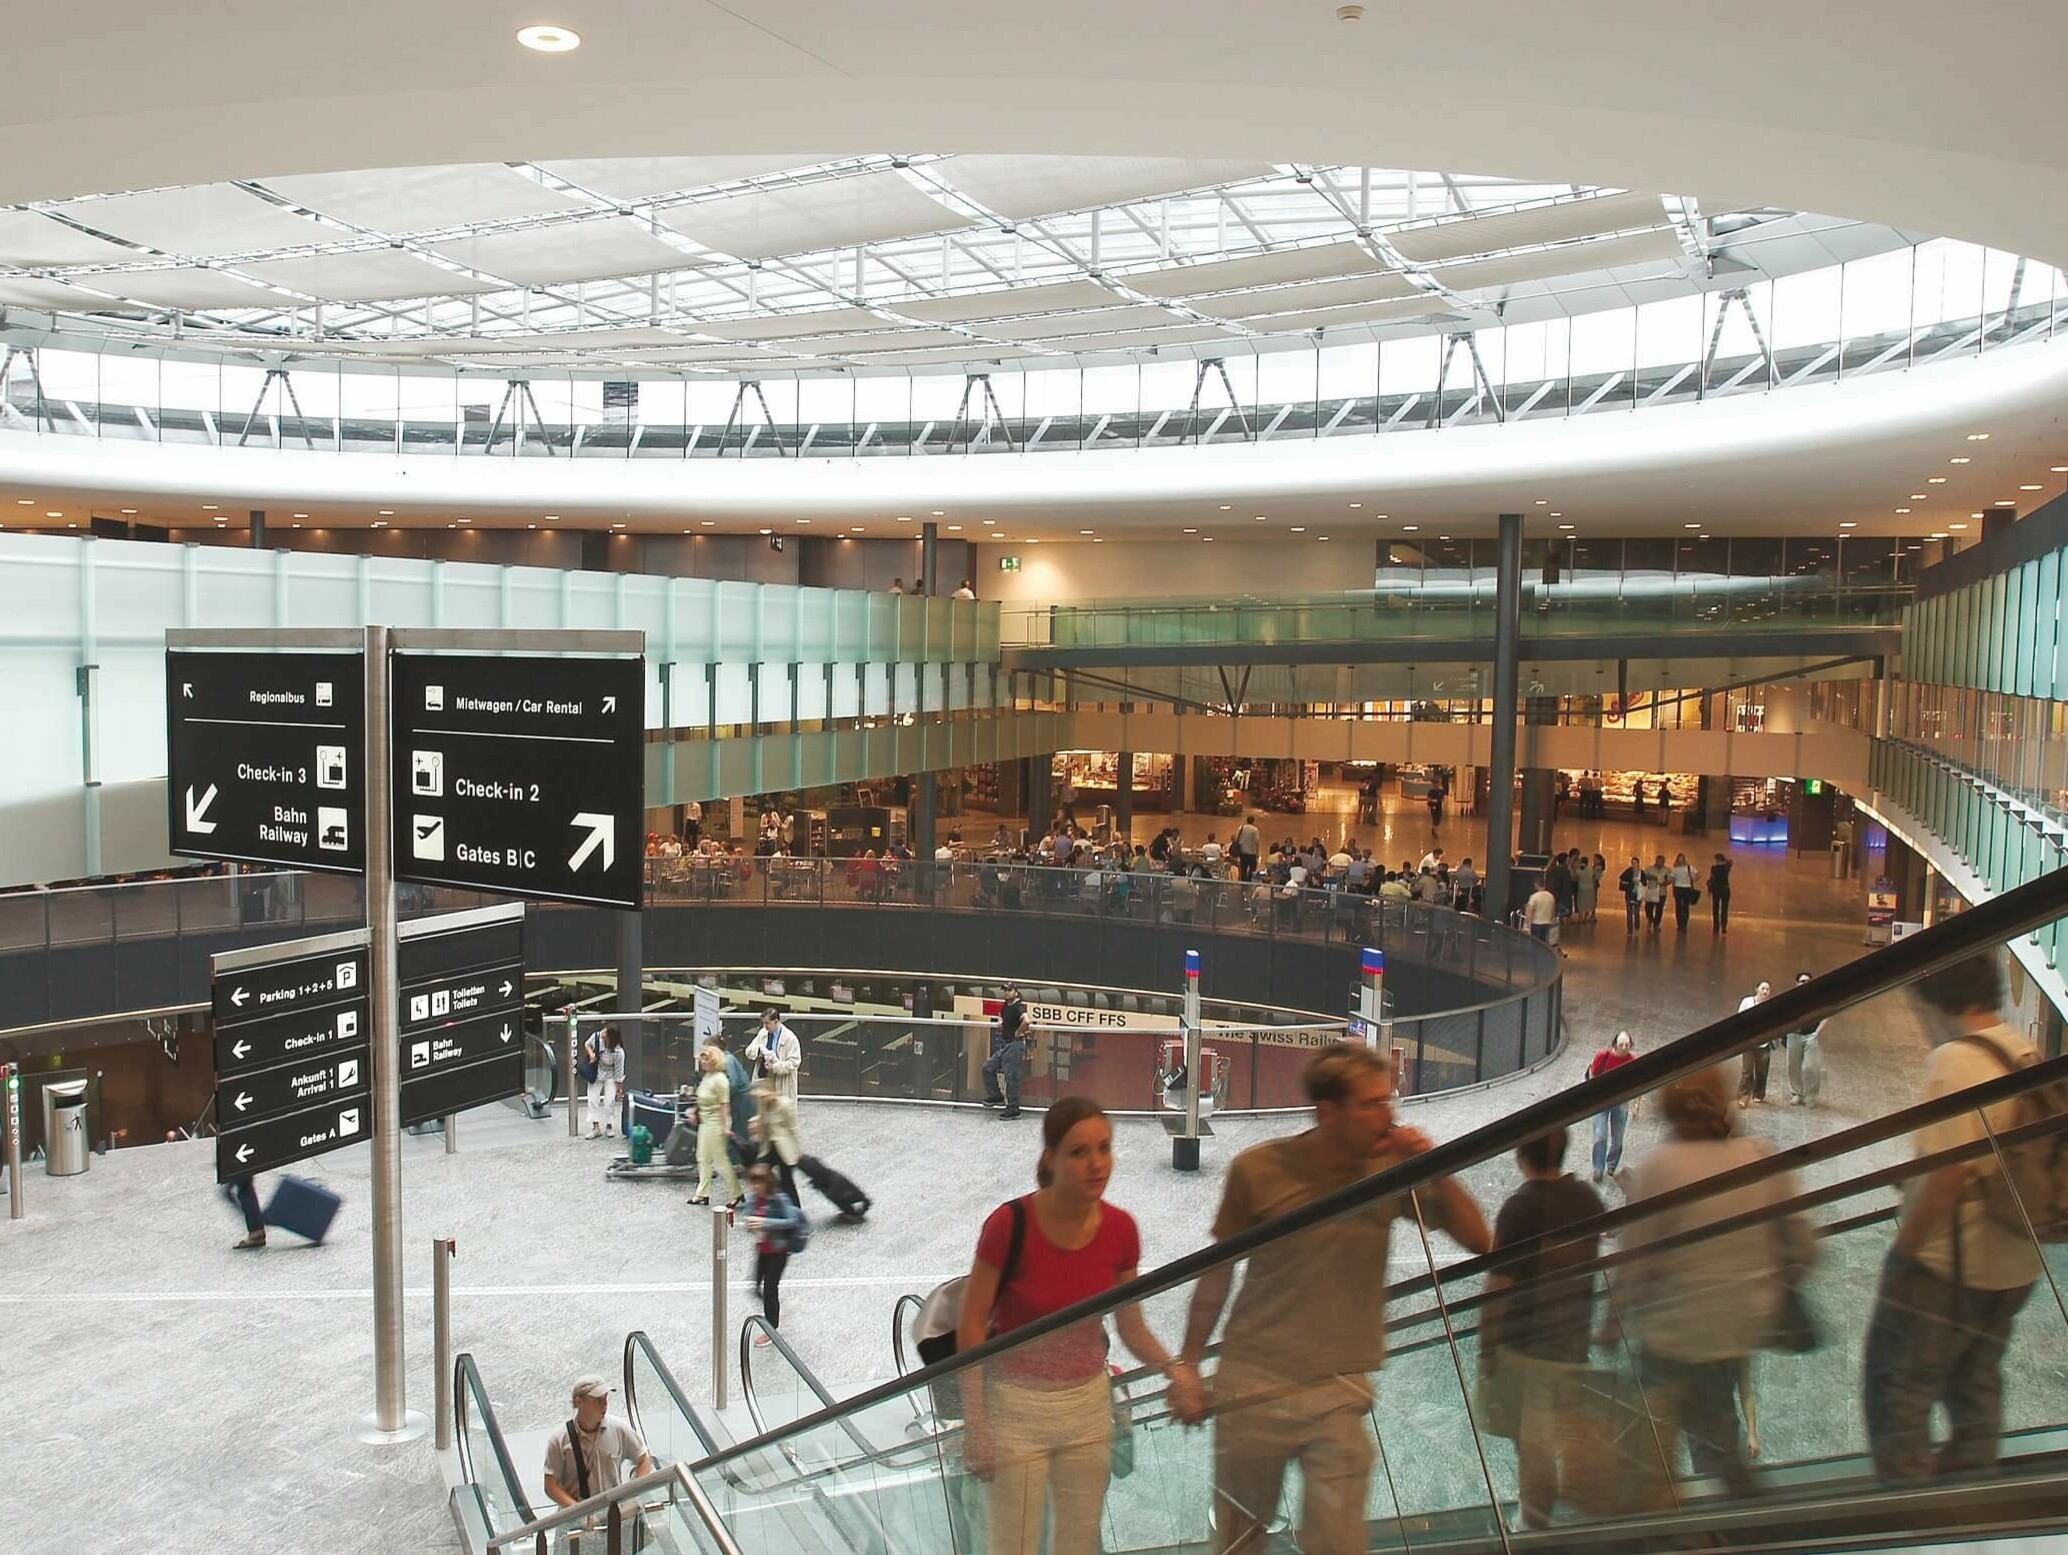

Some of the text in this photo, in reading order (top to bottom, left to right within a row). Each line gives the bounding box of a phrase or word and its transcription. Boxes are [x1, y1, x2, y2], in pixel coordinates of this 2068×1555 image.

[249, 690, 305, 705] Regionalbus
[456, 697, 513, 715] Mietwagen
[522, 699, 543, 713] Car
[546, 700, 583, 715] Rental
[237, 763, 307, 784] Check-in 3
[455, 778, 540, 802] Check-in 2
[274, 806, 307, 825] Bahn
[259, 825, 308, 847] Railway
[456, 843, 501, 865] Gates
[259, 988, 296, 1004] Parking
[452, 985, 485, 1000] Toiletten
[452, 997, 478, 1011] Toilets
[1032, 1006, 1127, 1027] SBB CFF FFS
[284, 1029, 334, 1050] Check-in 1
[433, 1038, 453, 1051] Bahn
[433, 1047, 463, 1062] Railway
[290, 1066, 334, 1089] Ankunft 1
[297, 1079, 335, 1098] Arrival 1
[300, 1127, 337, 1147] Gates A
